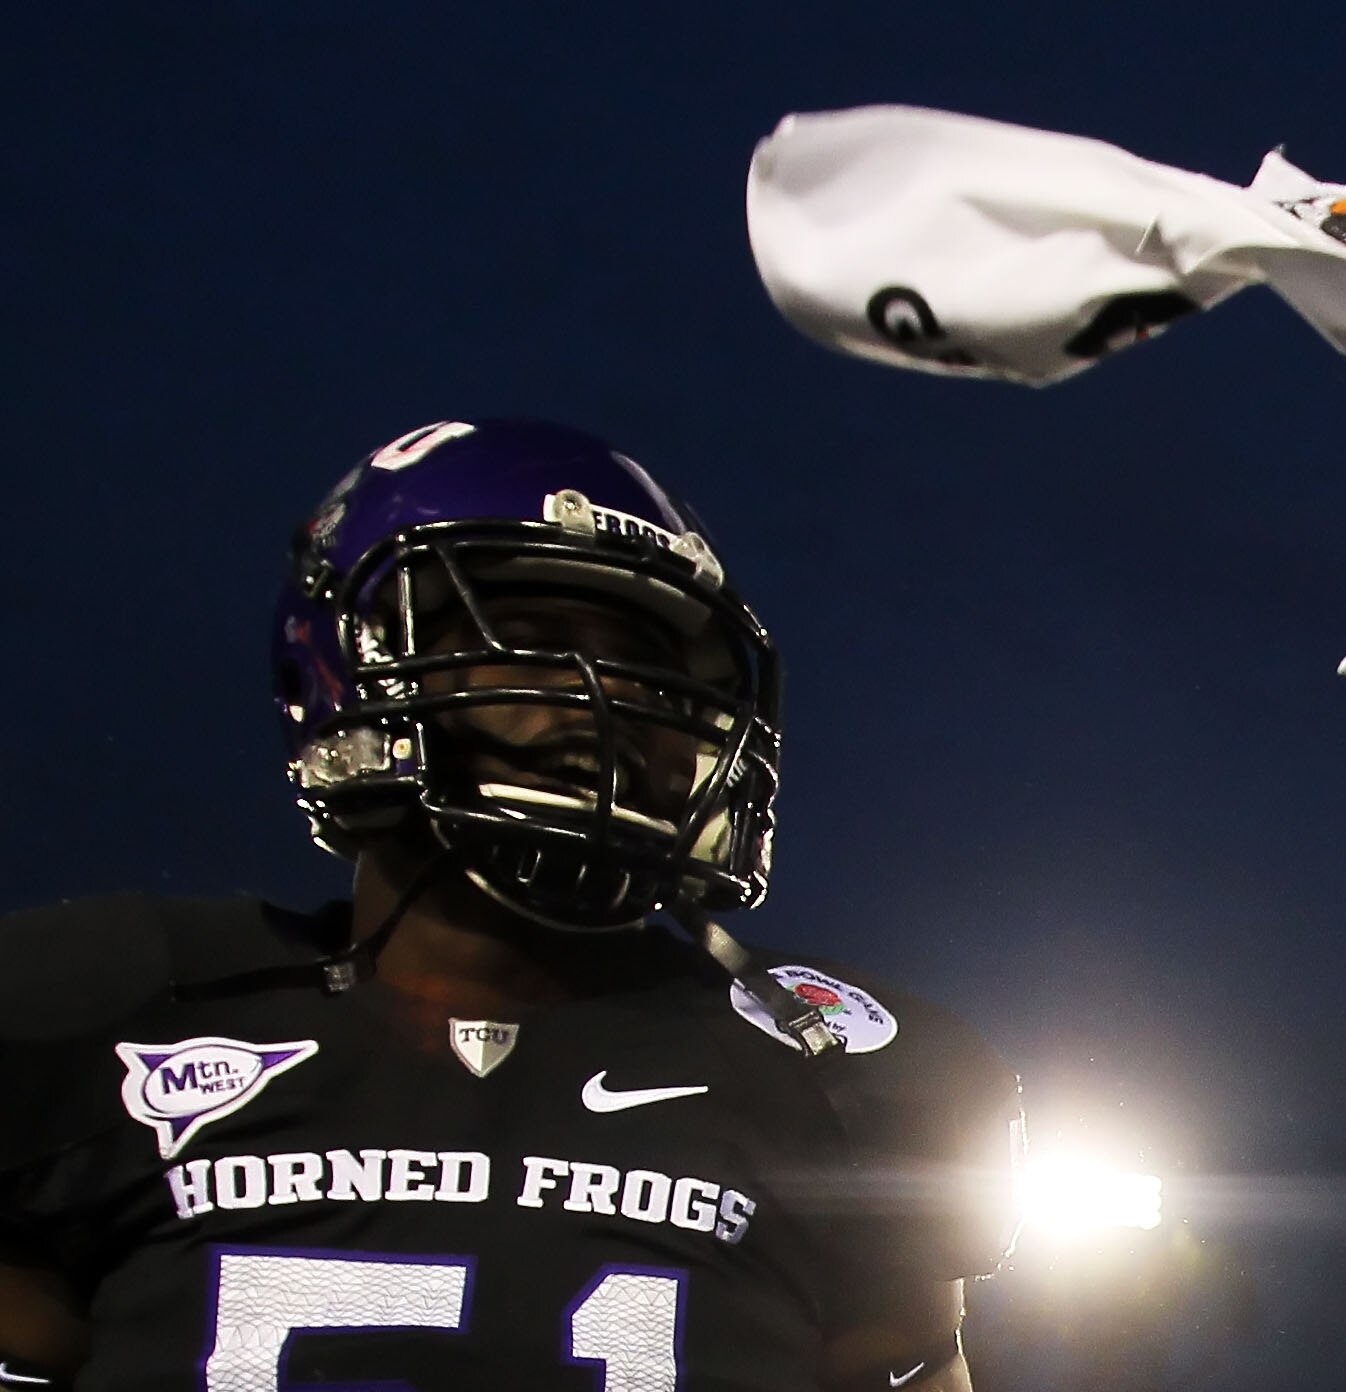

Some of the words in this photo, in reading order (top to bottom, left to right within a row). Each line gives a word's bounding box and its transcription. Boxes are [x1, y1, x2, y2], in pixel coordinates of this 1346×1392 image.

[458, 1027, 510, 1044] TCU
[201, 1075, 248, 1095] WEST
[165, 1149, 490, 1219] HORNED
[517, 1156, 757, 1244] FROGS
